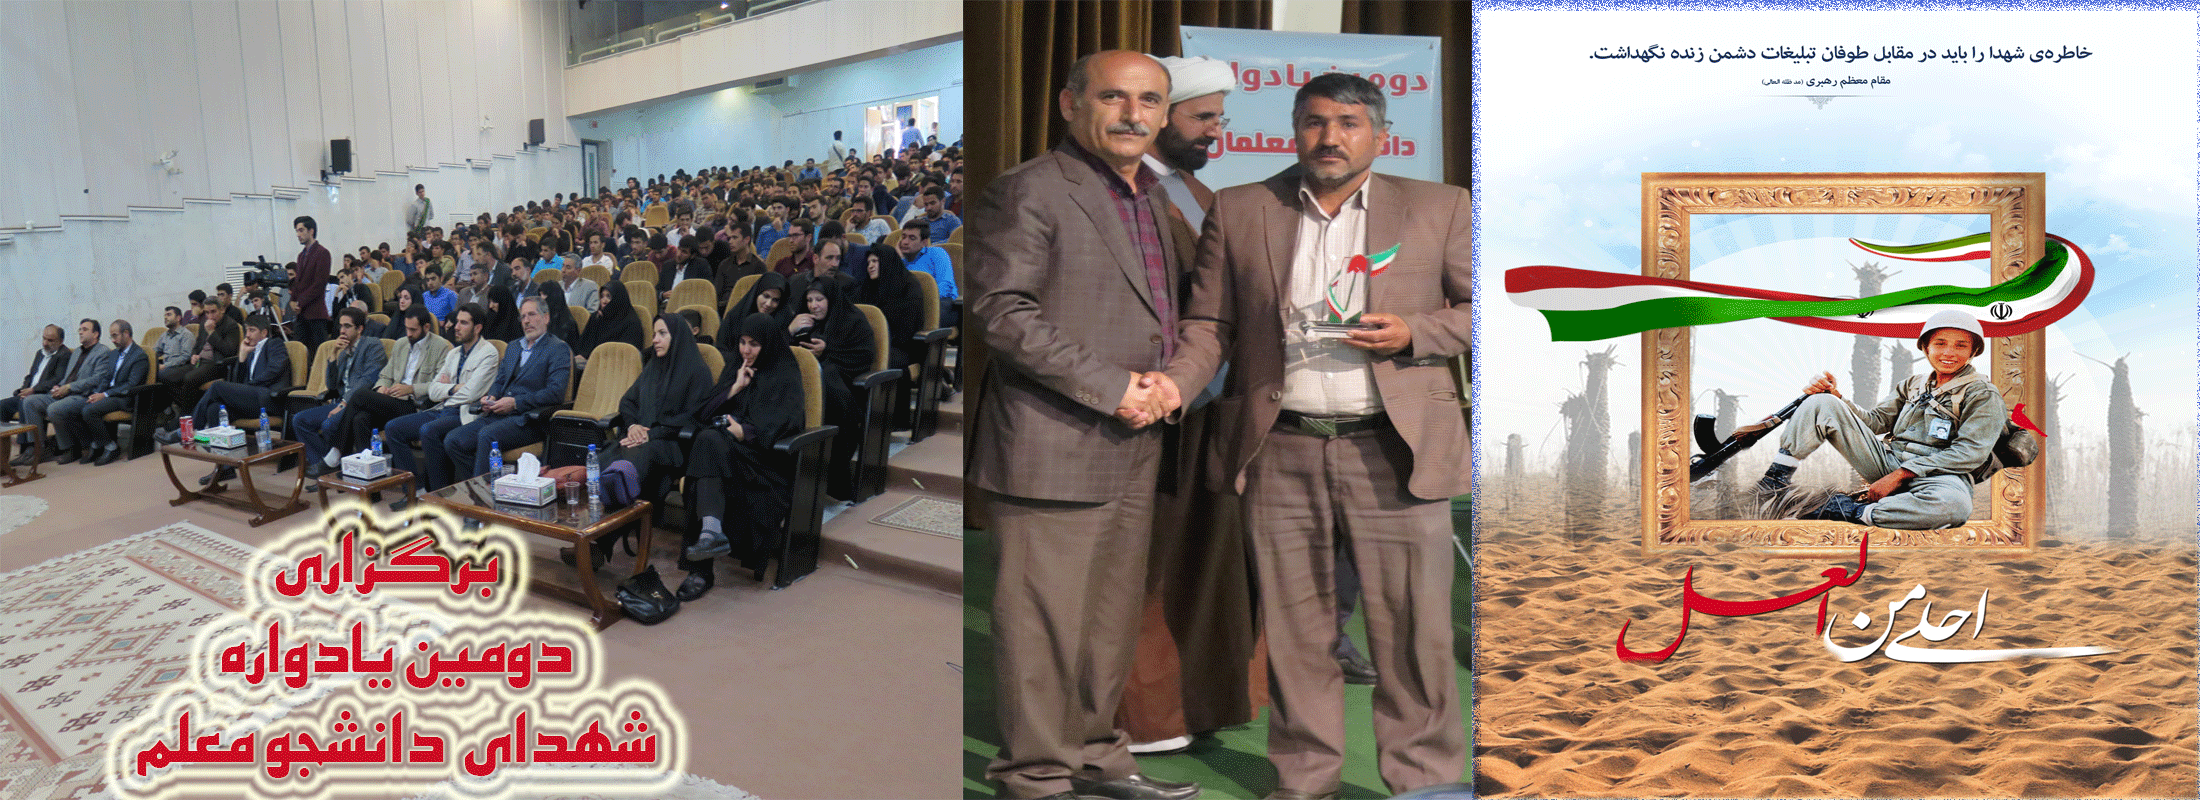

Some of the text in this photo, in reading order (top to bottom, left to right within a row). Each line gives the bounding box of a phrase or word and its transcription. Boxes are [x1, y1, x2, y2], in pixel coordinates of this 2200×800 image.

[1670, 47, 1704, 63] زنده
[1708, 46, 1757, 64] دشمن
[1760, 45, 1816, 64] تبلیغات
[1821, 45, 1869, 64] طوفان
[1873, 45, 1914, 64] مقابل
[1917, 49, 1937, 63] در
[1941, 45, 1968, 64] باید
[1972, 46, 1985, 63] را
[1989, 45, 2025, 63] شهدا
[1805, 77, 1838, 88] رهبری
[1839, 75, 1869, 90] معظم
[1870, 75, 1891, 89] مقام
[1822, 583, 1927, 663] من
